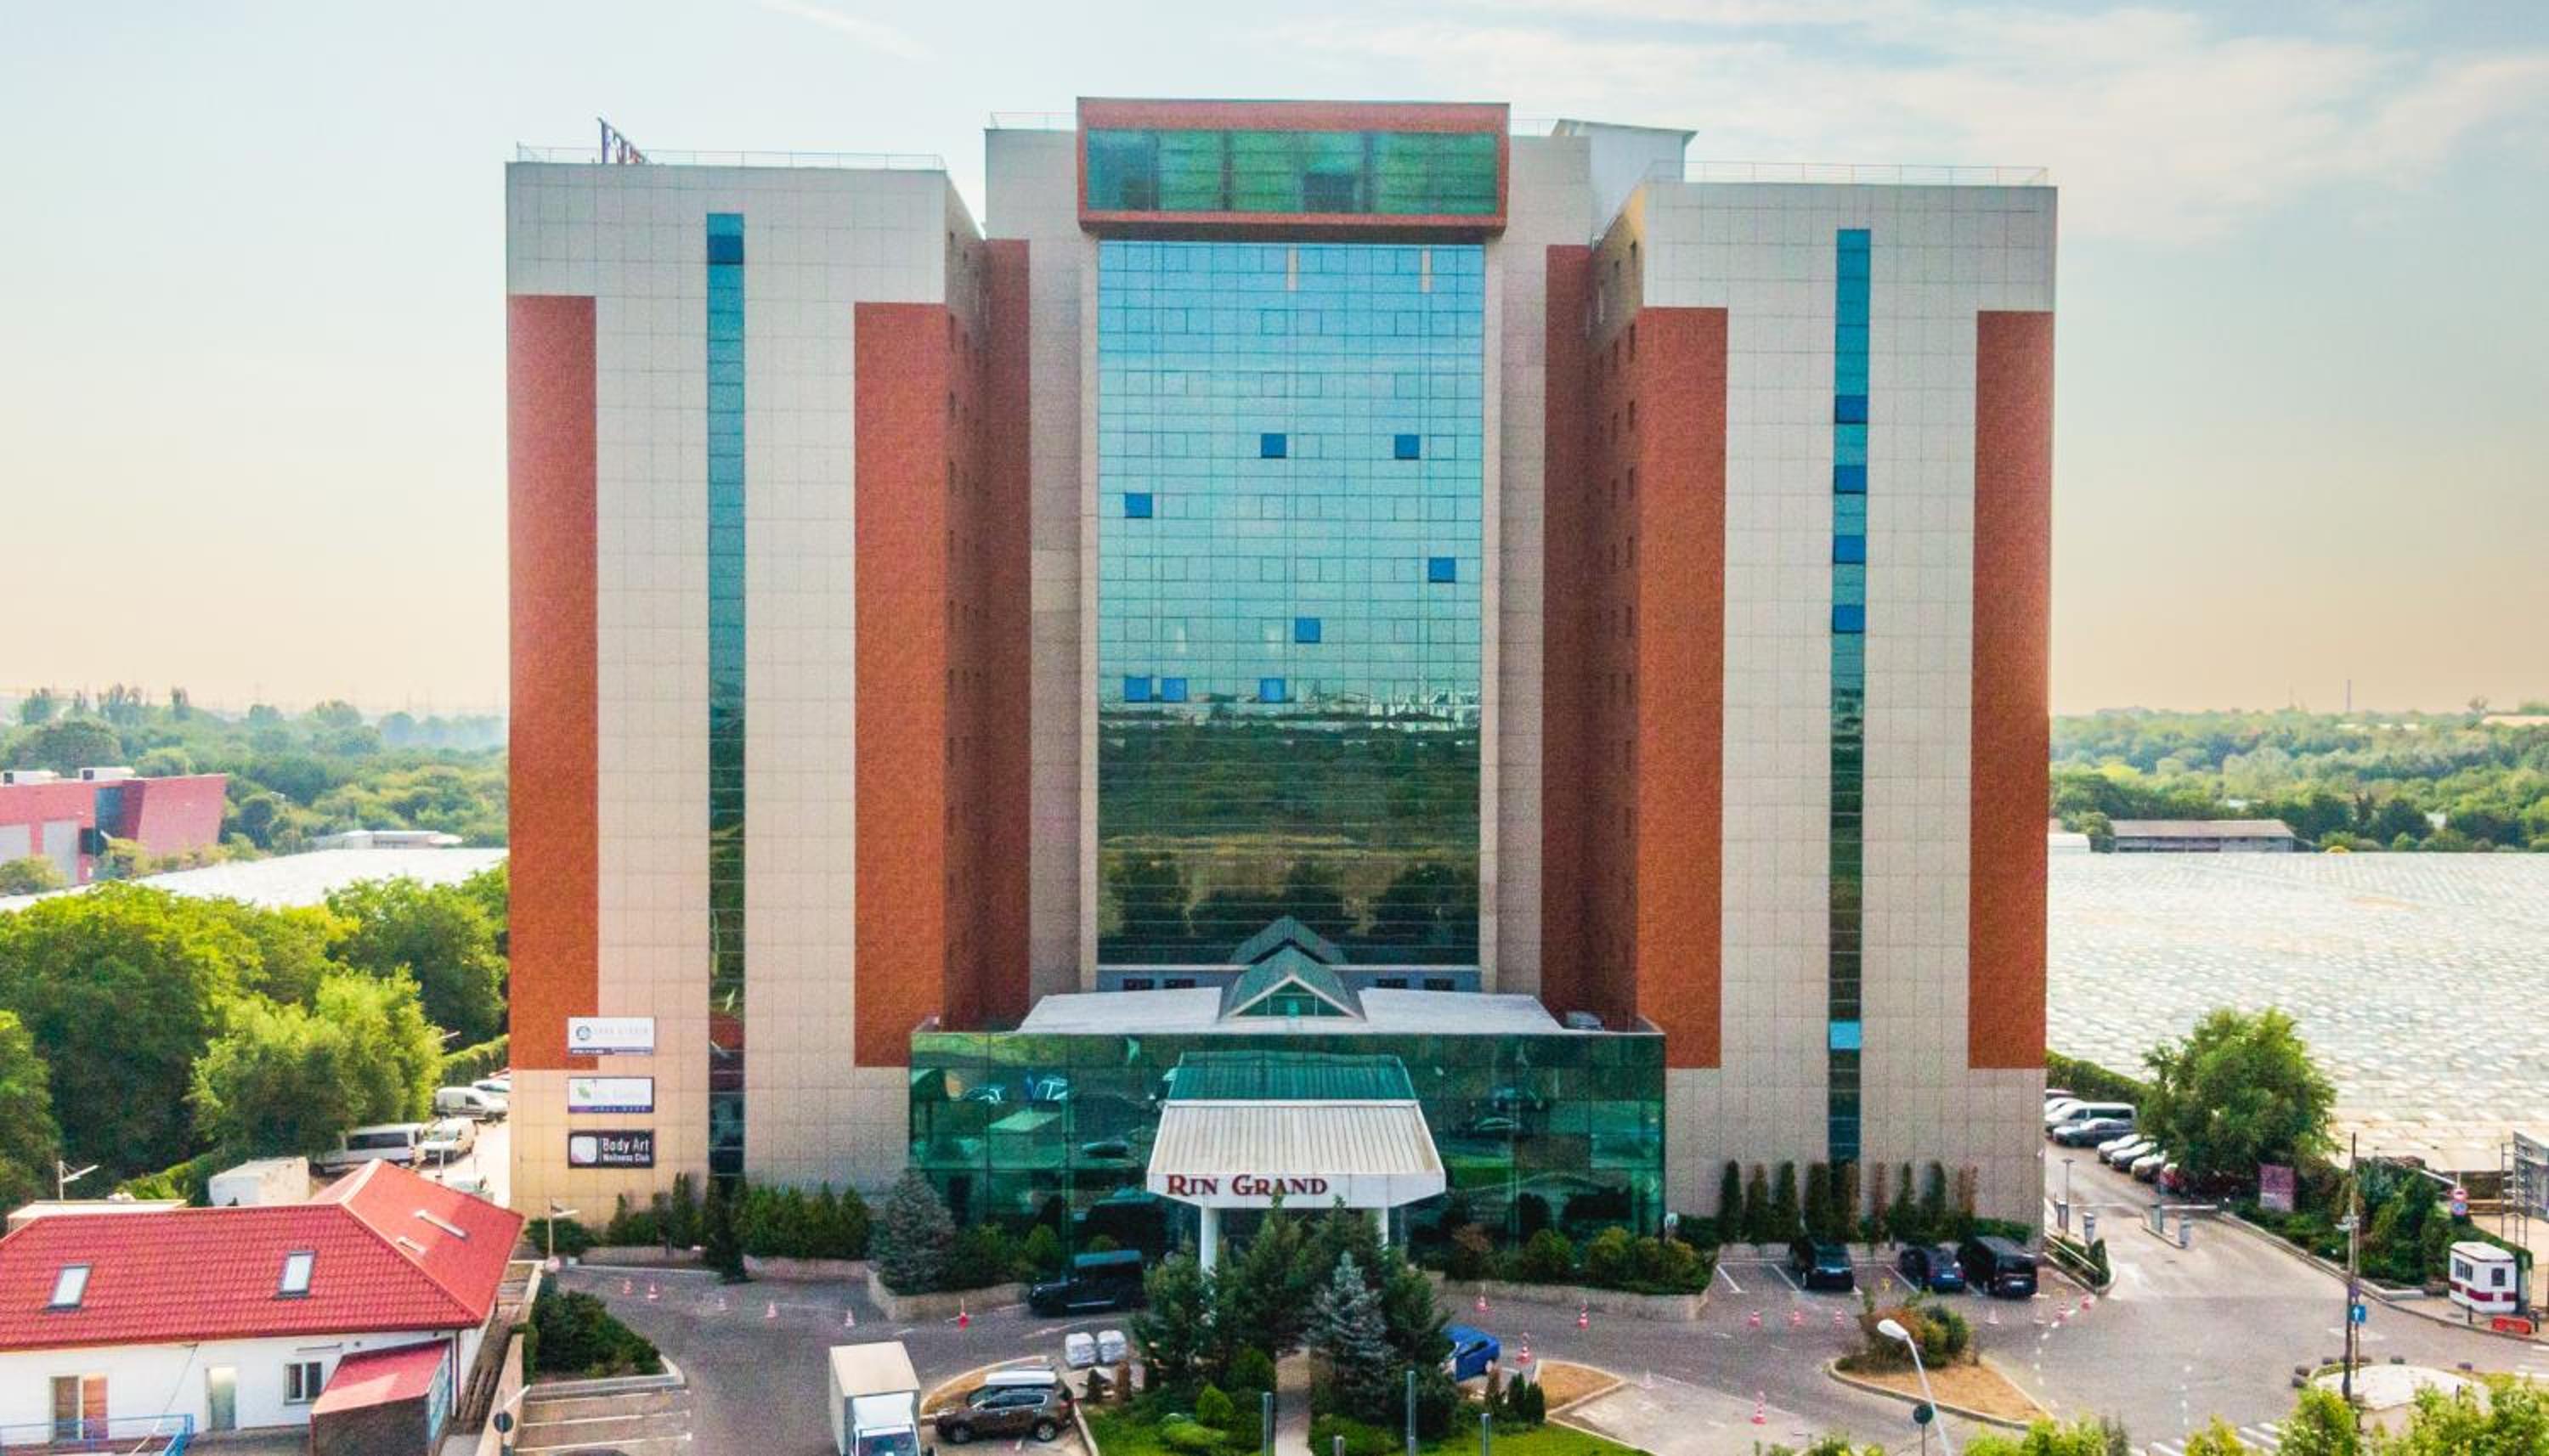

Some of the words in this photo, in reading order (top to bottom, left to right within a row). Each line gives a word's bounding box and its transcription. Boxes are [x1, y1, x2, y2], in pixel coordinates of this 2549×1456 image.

[602, 1137, 630, 1154] Body
[634, 1137, 650, 1152] Art
[1167, 1174, 1218, 1196] RIN
[1231, 1174, 1328, 1196] GRAND
